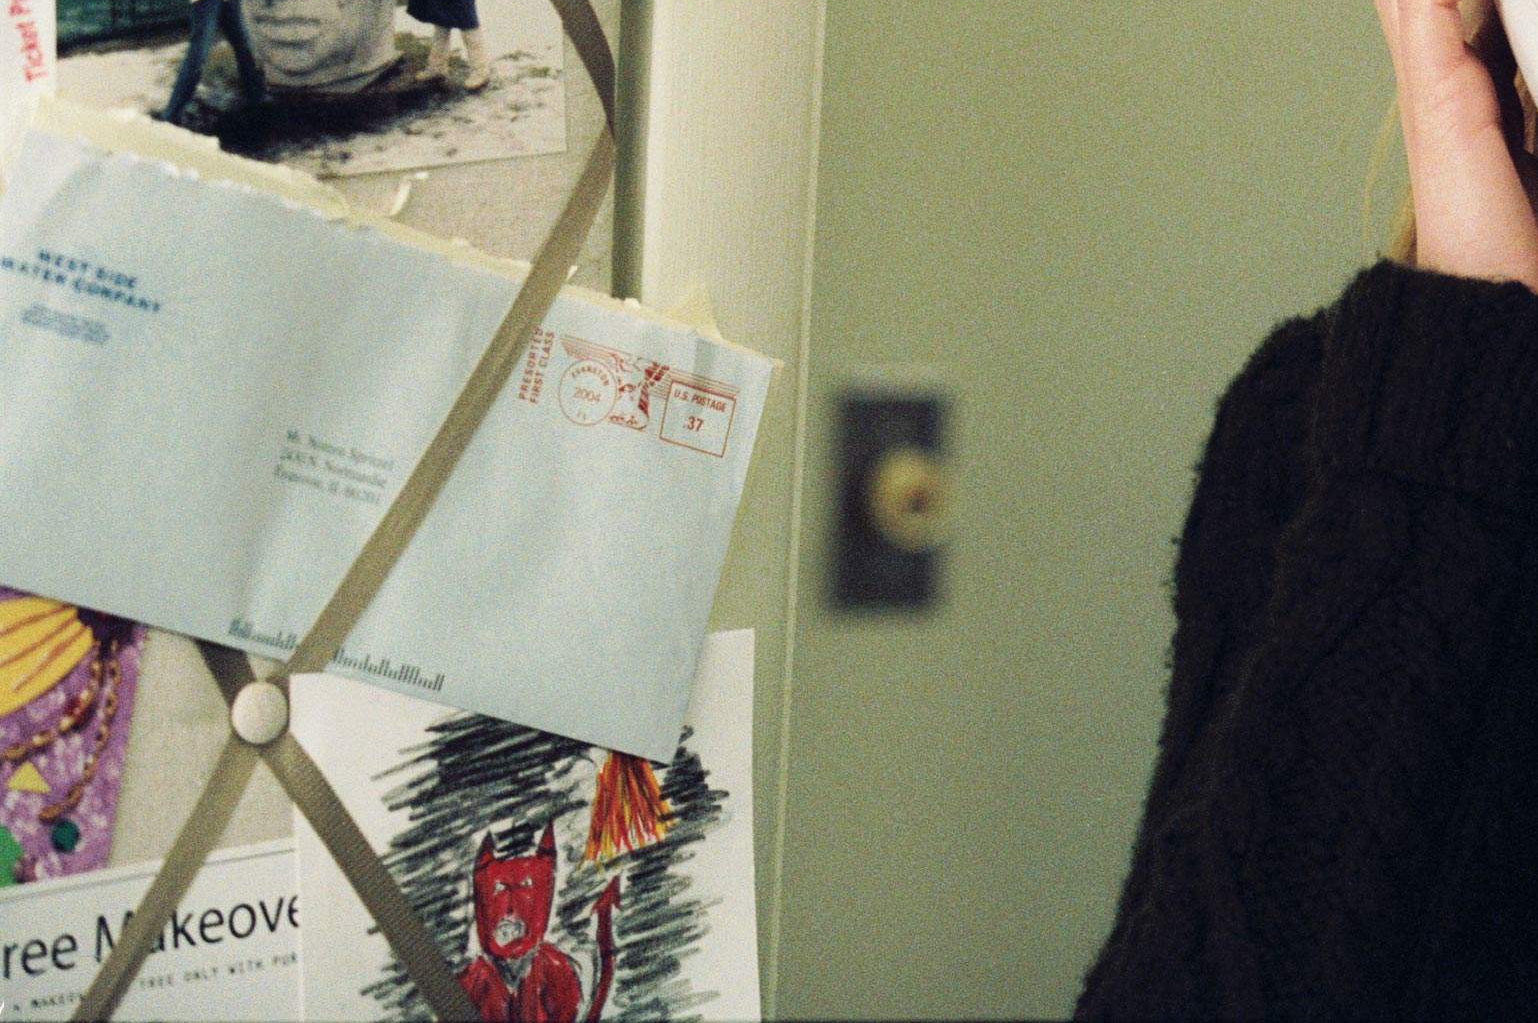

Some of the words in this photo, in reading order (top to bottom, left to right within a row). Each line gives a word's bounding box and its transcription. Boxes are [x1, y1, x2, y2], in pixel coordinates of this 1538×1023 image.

[529, 371, 544, 404] FIRST
[538, 331, 556, 369] CLASS
[691, 393, 727, 414] POSTAGE
